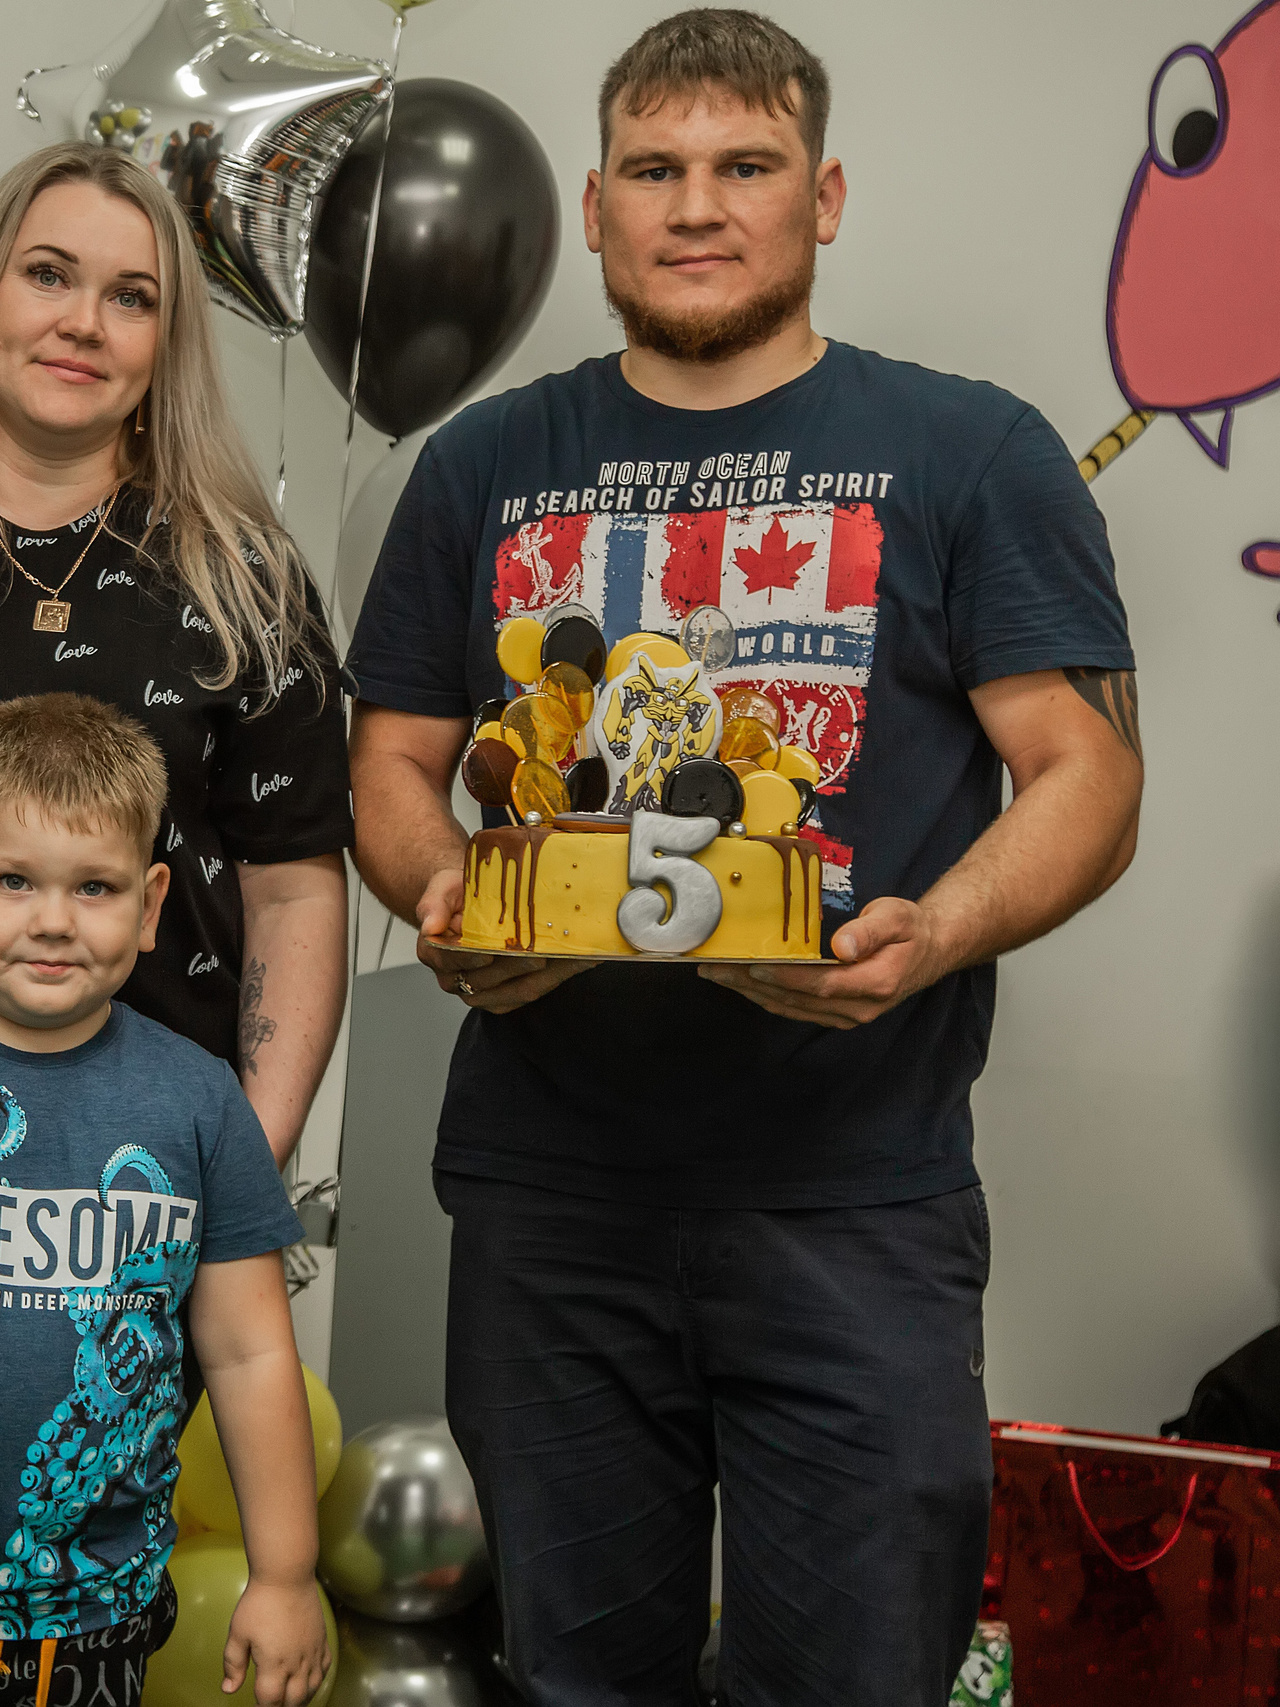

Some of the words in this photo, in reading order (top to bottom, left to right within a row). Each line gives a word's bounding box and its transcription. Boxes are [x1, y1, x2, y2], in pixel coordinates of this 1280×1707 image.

[598, 461, 690, 486] NORTH
[698, 450, 791, 480] OCEAN
[501, 496, 527, 524] IN
[534, 487, 634, 516] SEARCH
[645, 487, 680, 510] OF
[690, 476, 786, 508] SAILOR
[798, 472, 894, 498] SPIRIT
[97, 568, 136, 590] love
[54, 641, 98, 662] love
[737, 632, 836, 658] WORLD
[144, 680, 184, 706] love
[251, 772, 293, 802] love
[618, 810, 723, 954] 5
[21, 1292, 68, 1311] DEEP
[78, 1294, 157, 1312] MONSTERS
